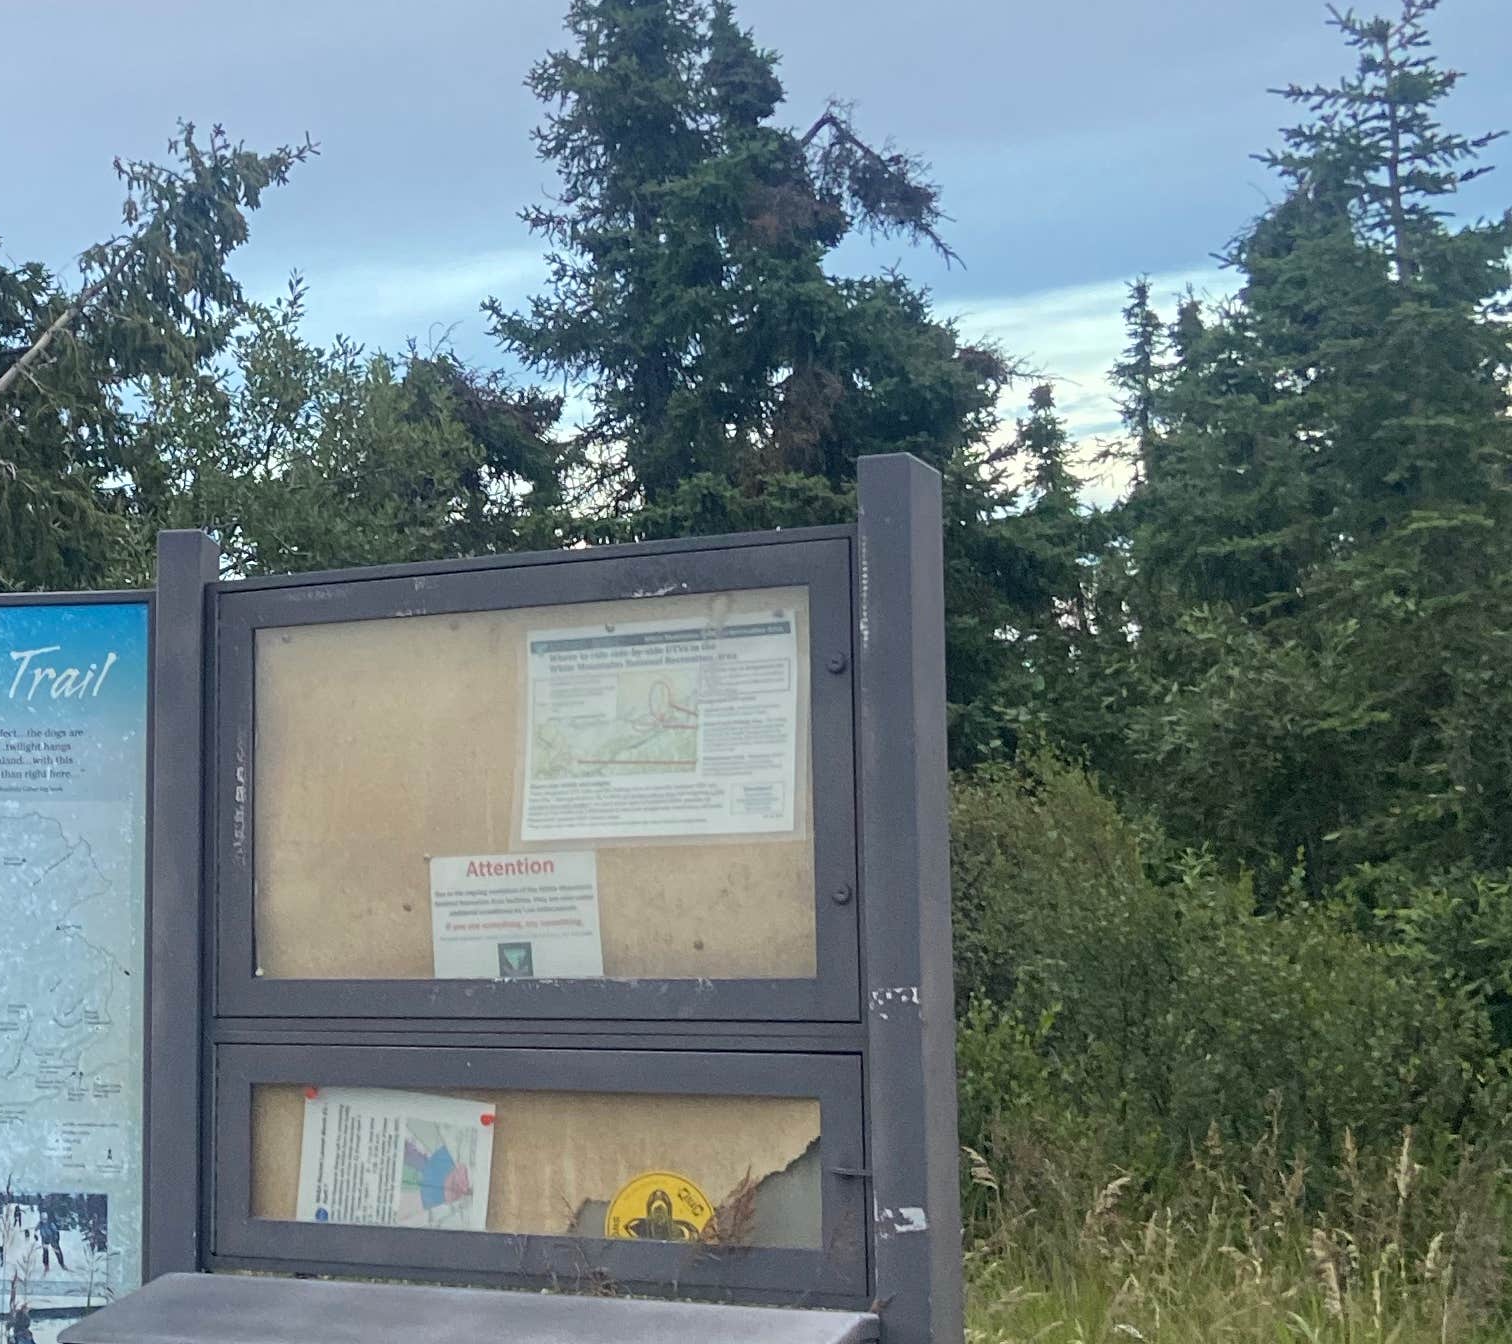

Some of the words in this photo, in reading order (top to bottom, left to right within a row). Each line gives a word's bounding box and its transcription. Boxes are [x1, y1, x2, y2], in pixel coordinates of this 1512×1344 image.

[7, 645, 117, 701] Trail
[44, 728, 66, 739] dogs
[43, 742, 71, 752] hangs
[55, 756, 74, 764] this
[1, 769, 22, 778] than
[24, 769, 48, 780] right
[466, 856, 556, 878] Attention
